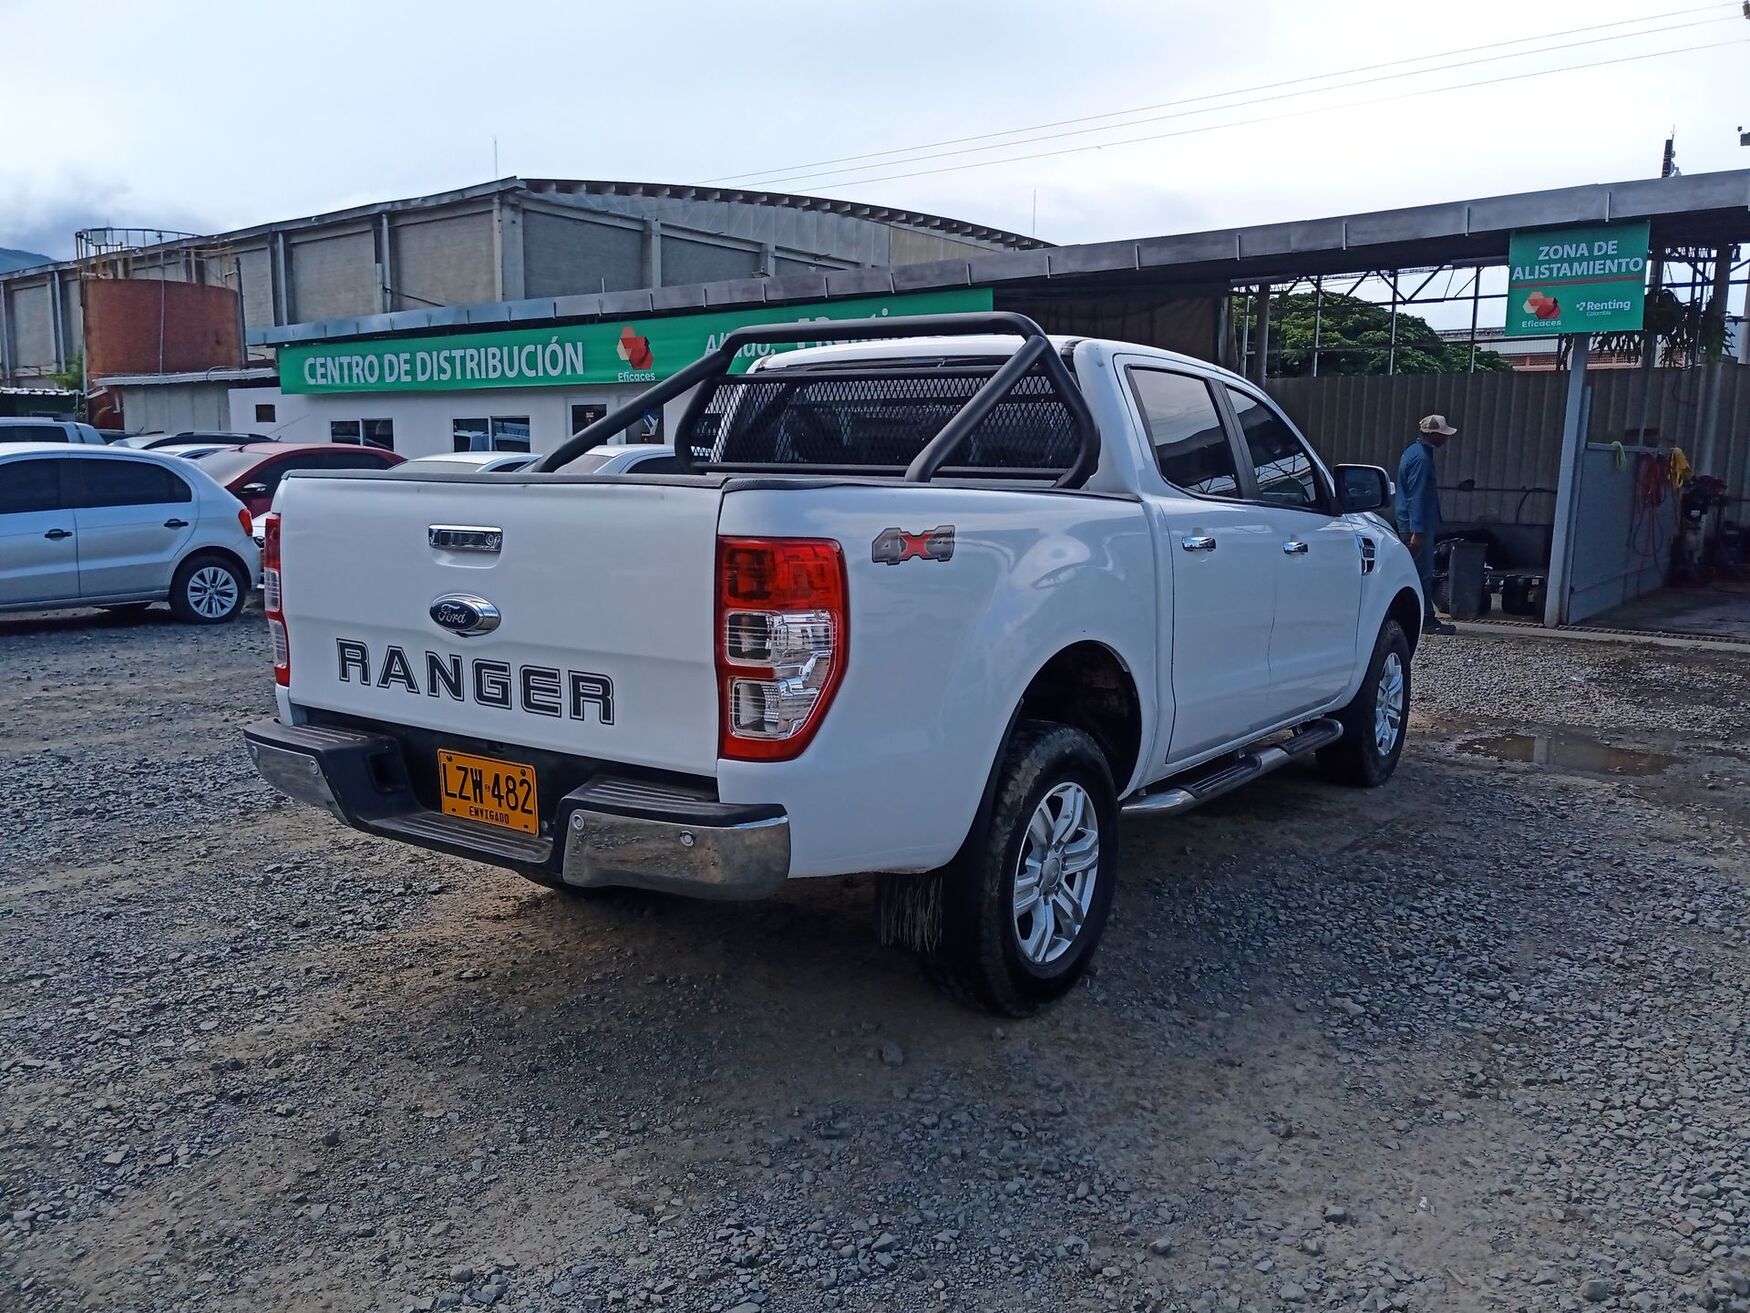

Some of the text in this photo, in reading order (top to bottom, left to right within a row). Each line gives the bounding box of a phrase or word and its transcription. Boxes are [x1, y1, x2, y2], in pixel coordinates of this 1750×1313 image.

[1538, 240, 1618, 261] ZONA DE
[1512, 257, 1644, 281] ALISTAMIENTO
[1586, 299, 1631, 311] Renting
[1521, 320, 1562, 328] Eficaces
[303, 336, 584, 386] CENTRO DE DISTRIBUCIÓN
[617, 371, 656, 382] Eficaces
[438, 603, 467, 624] Ford
[336, 637, 615, 726] RANGER
[491, 771, 534, 815] 482
